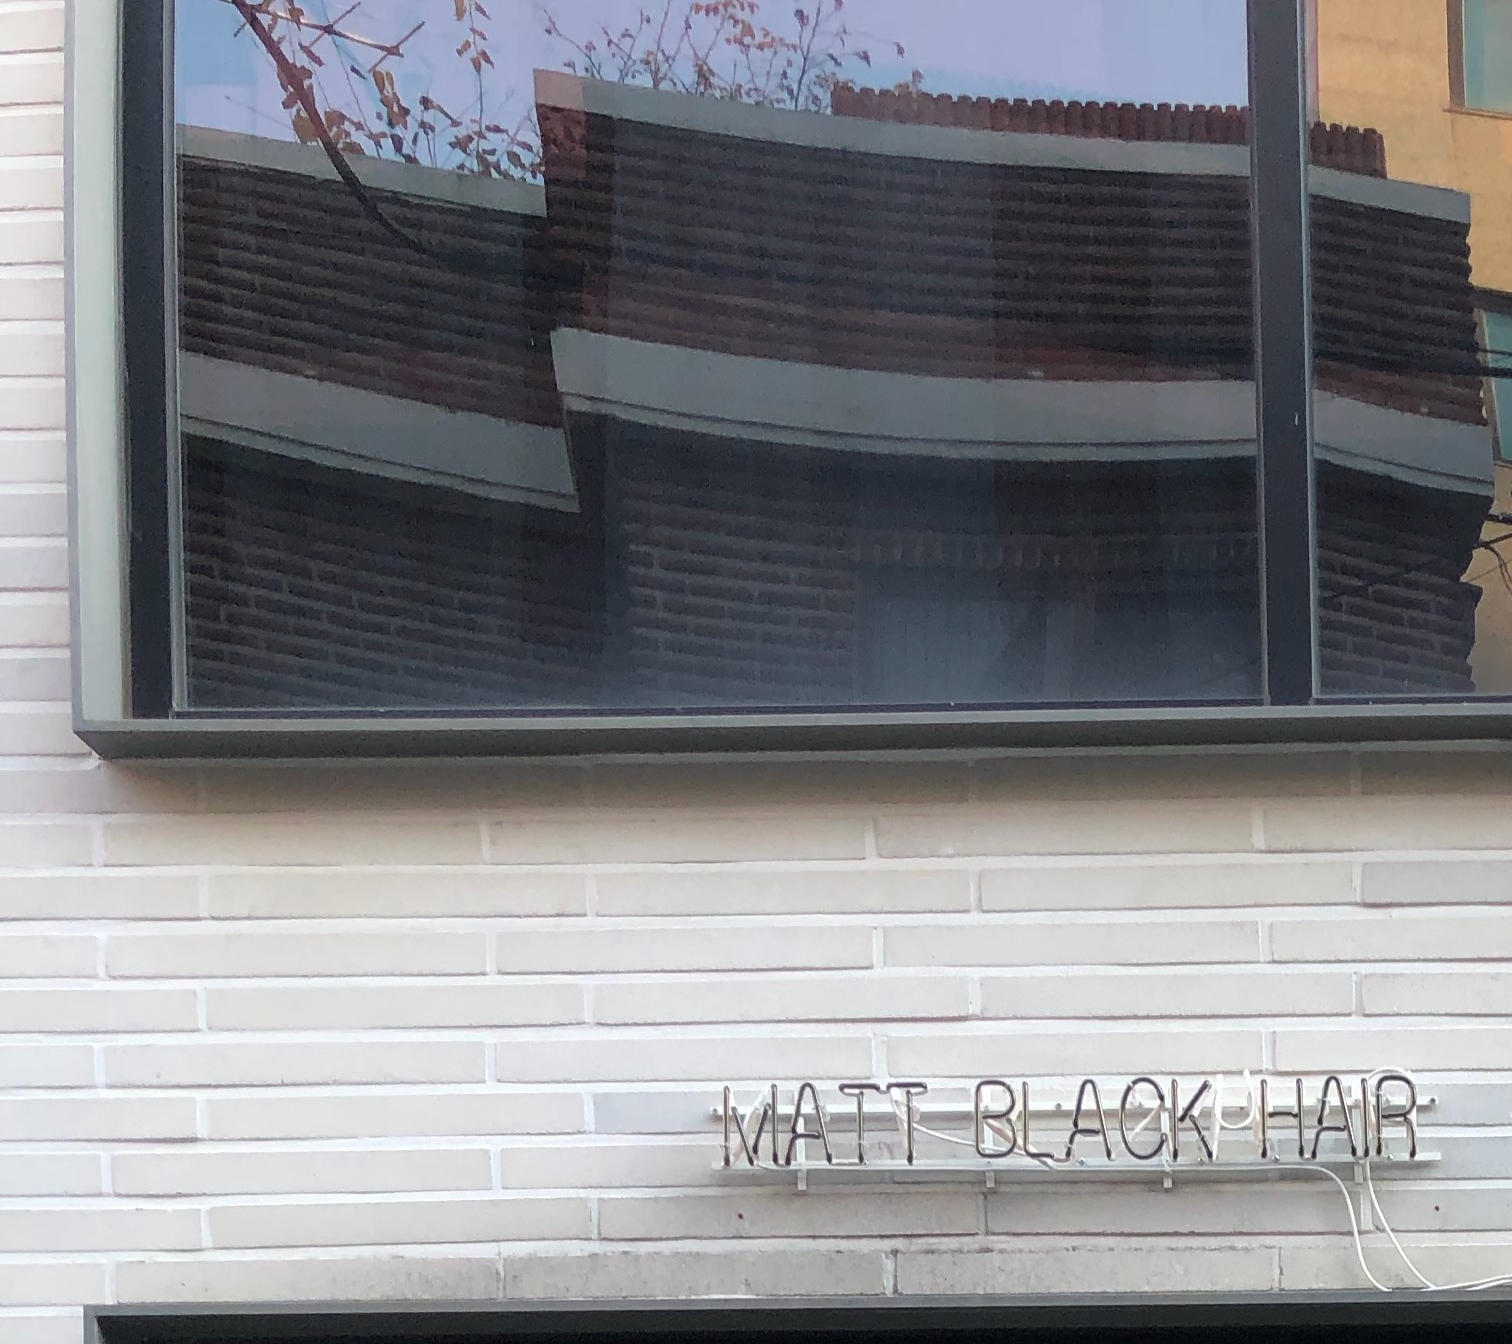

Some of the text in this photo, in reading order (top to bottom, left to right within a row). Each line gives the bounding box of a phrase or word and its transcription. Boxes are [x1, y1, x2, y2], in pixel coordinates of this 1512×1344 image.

[722, 1074, 1418, 1166] MATT BLACK HAIR
